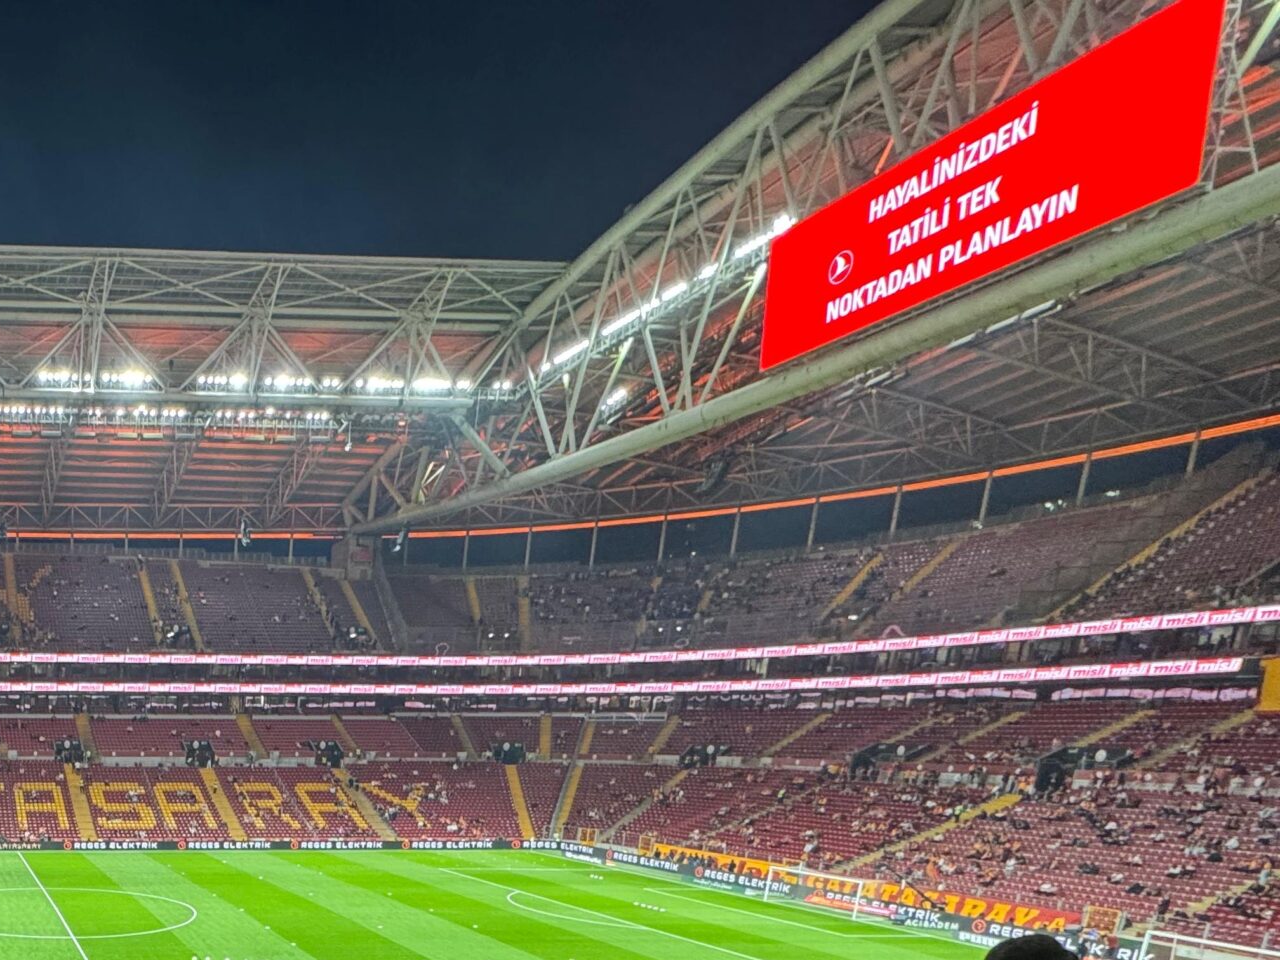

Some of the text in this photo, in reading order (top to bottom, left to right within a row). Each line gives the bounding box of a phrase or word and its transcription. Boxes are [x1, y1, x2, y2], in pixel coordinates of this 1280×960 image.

[868, 100, 1040, 223] HAYALİNİZDEKİ
[887, 176, 1004, 255] TATİLİ TEK
[826, 184, 1080, 324] NOKTADAN PLANLAYIN
[1012, 627, 1042, 640] misli
[1083, 620, 1118, 633] misli
[1165, 611, 1205, 627] misli
[1002, 668, 1032, 681] misli
[1073, 664, 1107, 678] misli
[1153, 661, 1192, 675] misli
[704, 869, 735, 883] REGES
